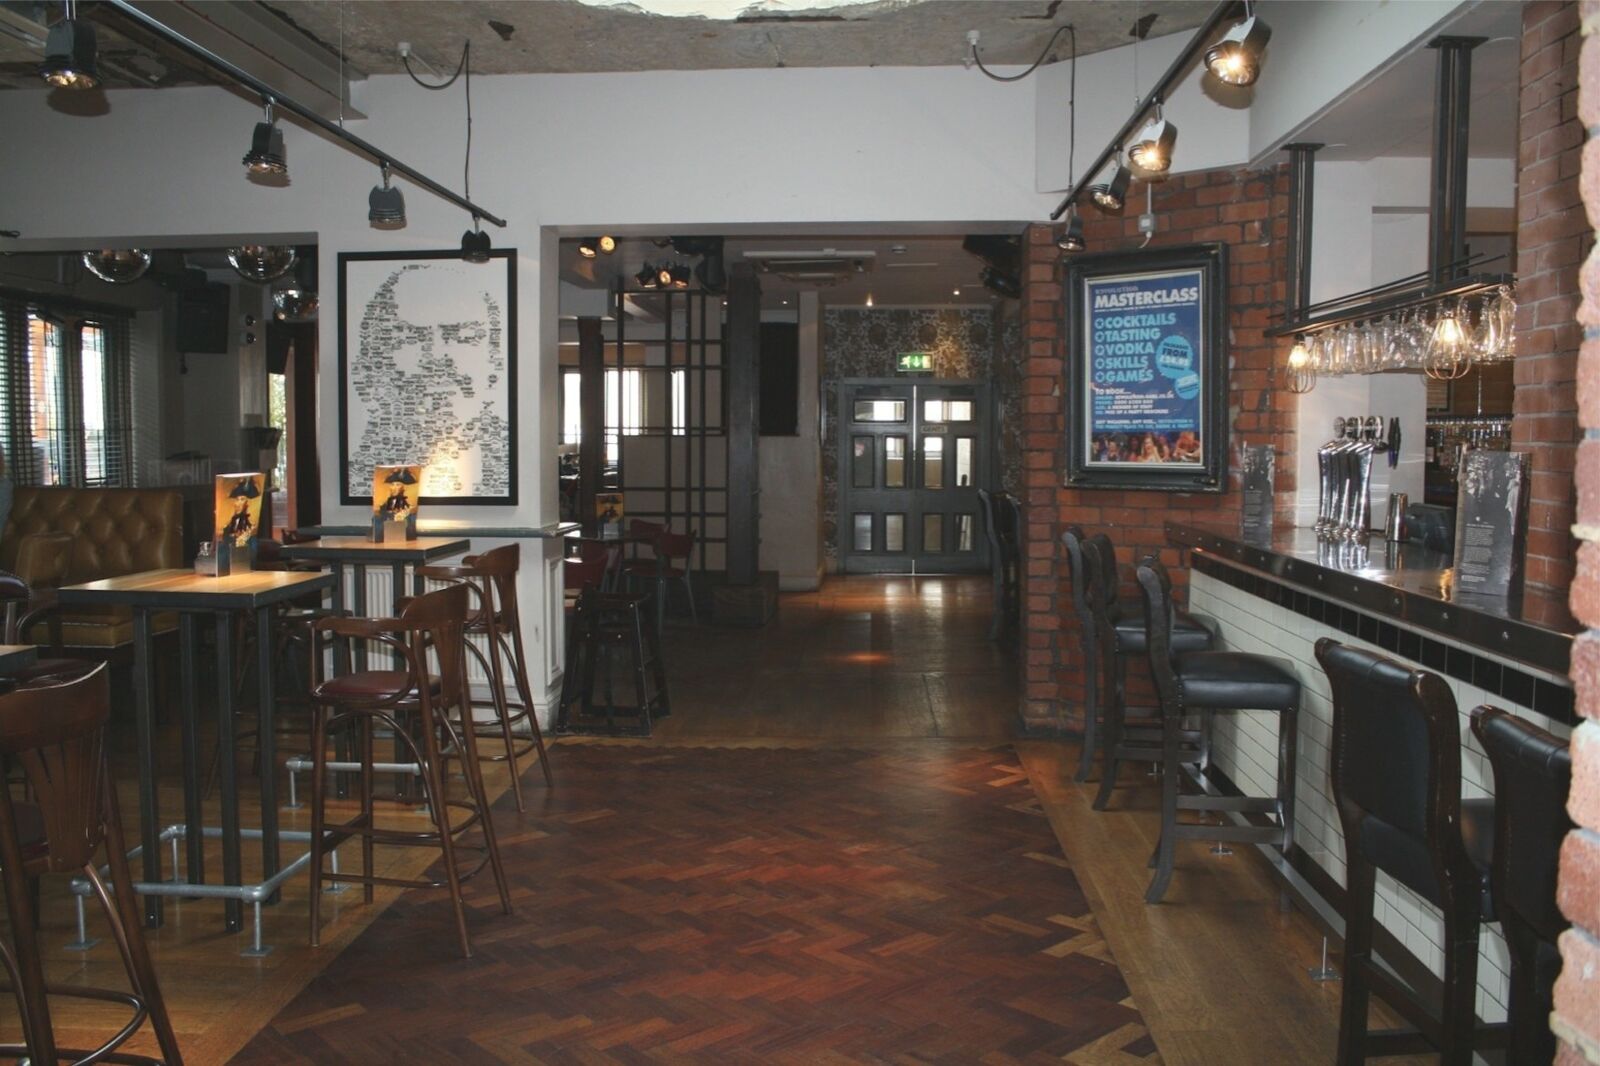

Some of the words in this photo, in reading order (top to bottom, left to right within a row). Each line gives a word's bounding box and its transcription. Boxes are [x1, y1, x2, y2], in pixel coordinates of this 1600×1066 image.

[1094, 287, 1198, 308] MASTERCLASS
[1105, 313, 1176, 329] COCKTAILS
[1105, 328, 1160, 342] TASTING
[1106, 342, 1154, 355] VODKA
[1162, 347, 1187, 358] FROM
[1106, 356, 1148, 369] SKILLS
[1106, 369, 1153, 382] GAMES
